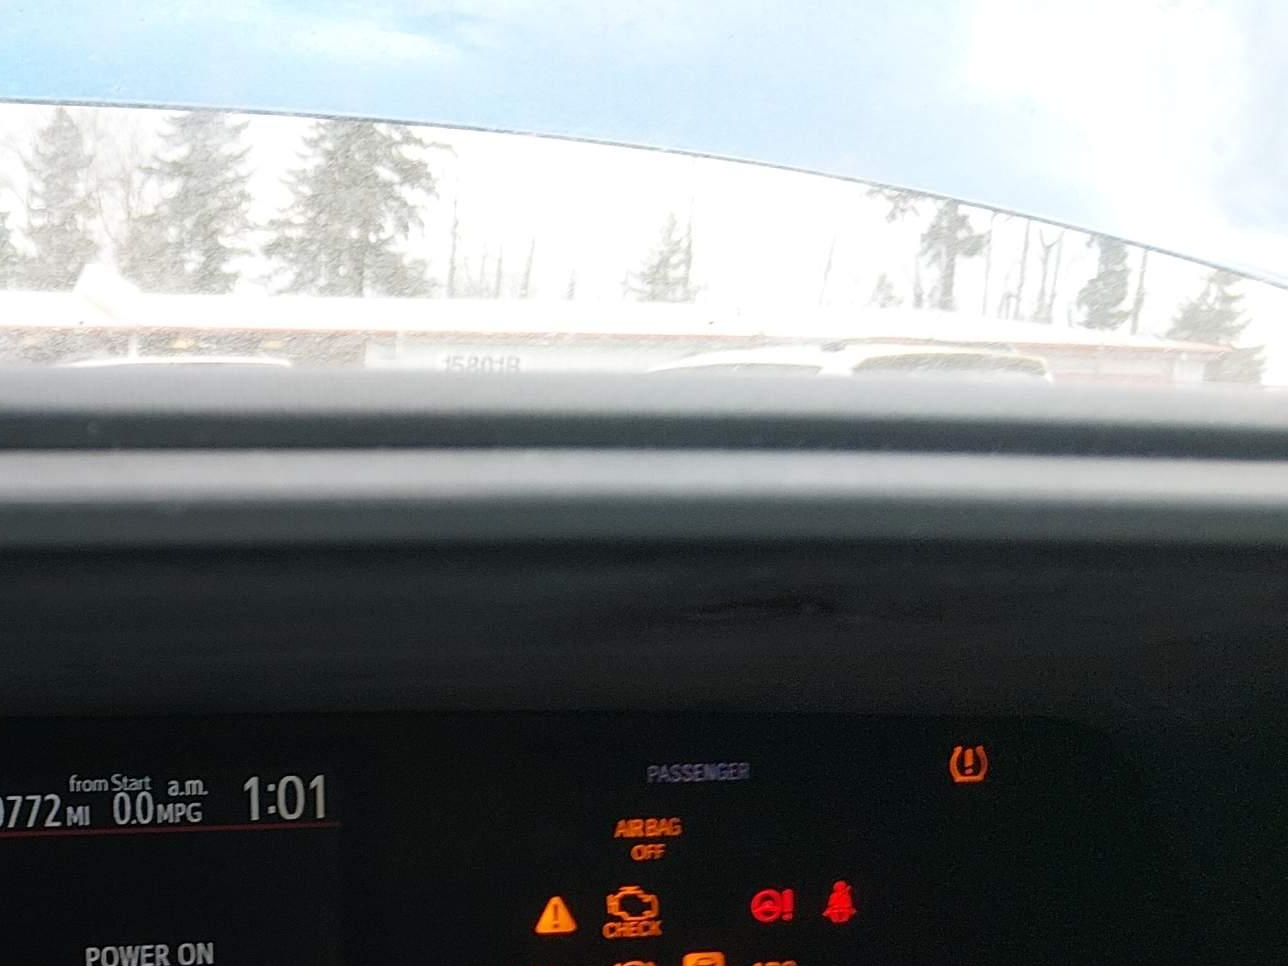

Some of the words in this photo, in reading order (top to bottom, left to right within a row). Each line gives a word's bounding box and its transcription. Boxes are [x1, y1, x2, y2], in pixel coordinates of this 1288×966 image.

[69, 774, 109, 792] from
[111, 773, 152, 792] Start
[647, 762, 751, 783] PASSENGER
[167, 779, 209, 797] a.m.
[243, 774, 326, 821] 1:01
[66, 805, 91, 827] MI
[113, 792, 154, 825] 0.0
[156, 802, 203, 824] MPG
[614, 817, 683, 838] AIRBAG
[630, 843, 666, 861] OFF
[601, 921, 663, 939] CHECK
[177, 942, 215, 966] ON
